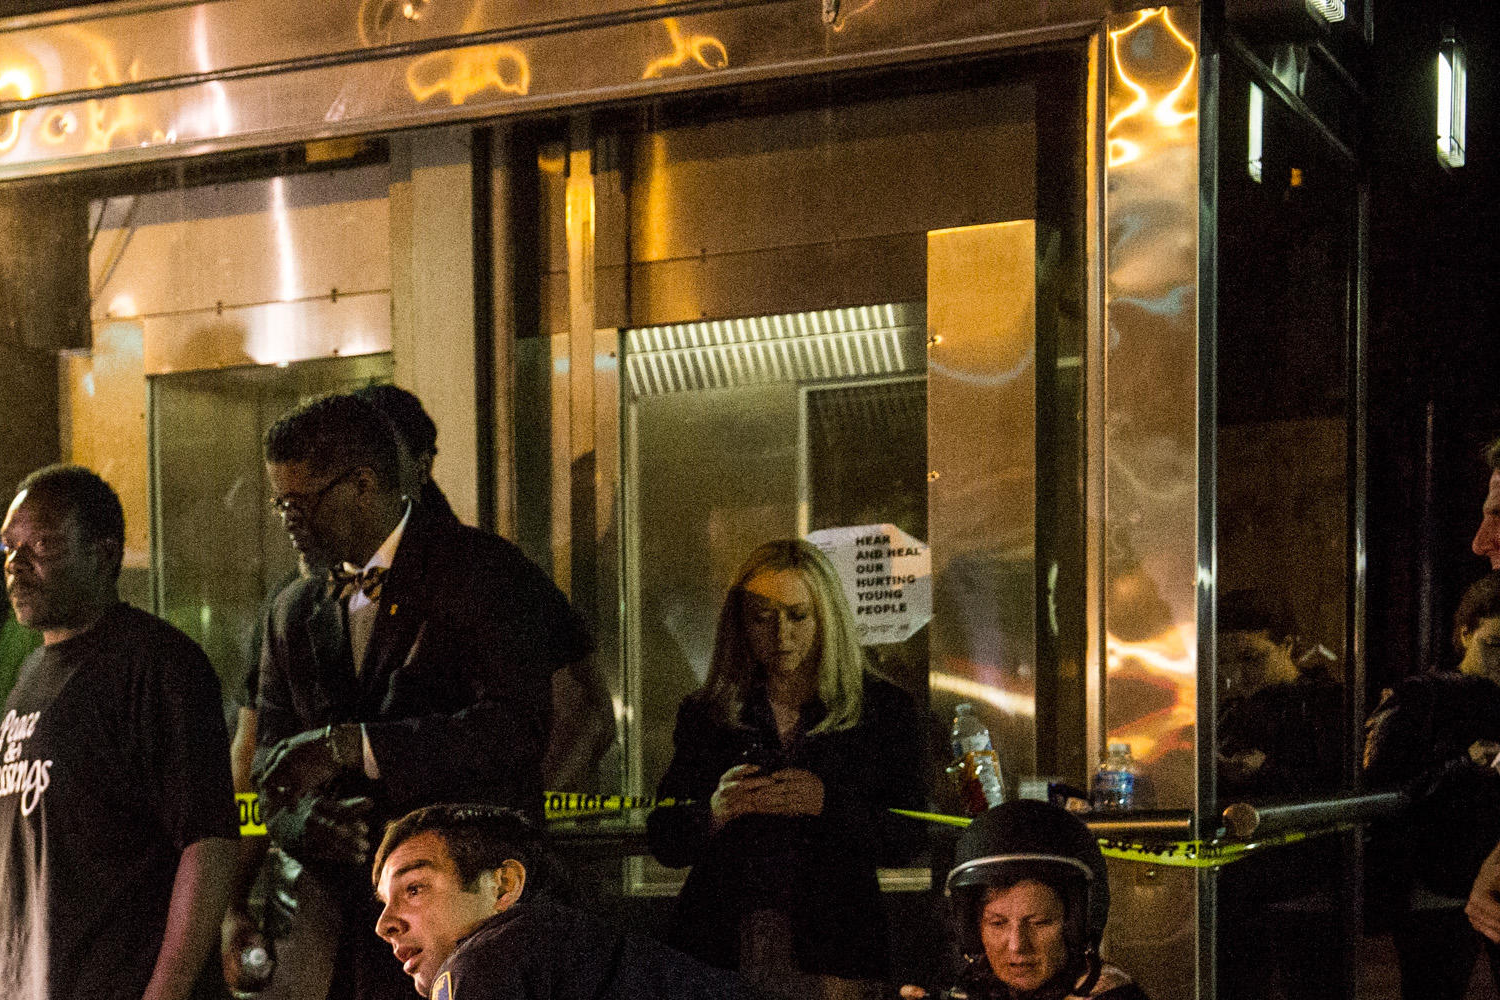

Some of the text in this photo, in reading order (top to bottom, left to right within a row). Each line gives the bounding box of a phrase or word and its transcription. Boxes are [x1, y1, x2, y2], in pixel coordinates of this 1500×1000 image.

[855, 534, 891, 546] HEAR
[855, 547, 921, 560] AND HEAL
[855, 563, 884, 574] OUR
[856, 574, 916, 588] HURTING
[857, 589, 903, 602] YOUNG
[857, 602, 907, 616] PEOPLE
